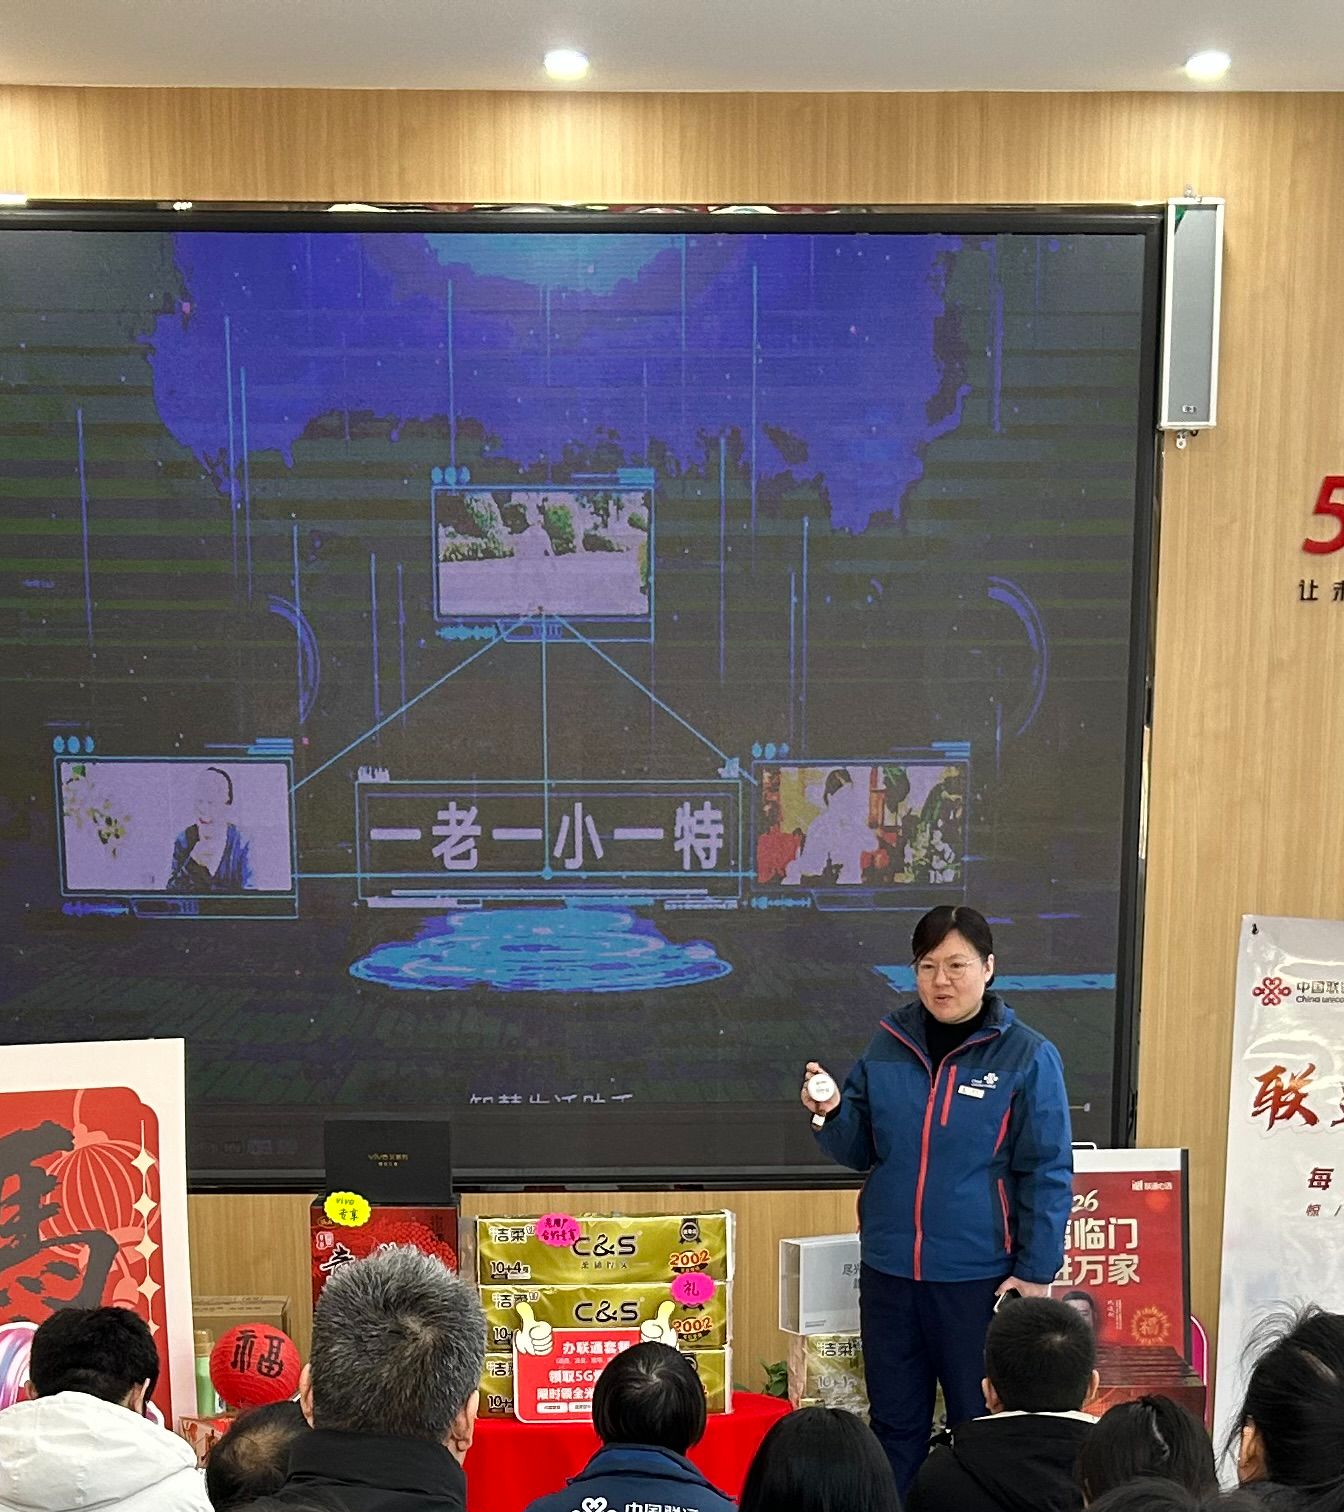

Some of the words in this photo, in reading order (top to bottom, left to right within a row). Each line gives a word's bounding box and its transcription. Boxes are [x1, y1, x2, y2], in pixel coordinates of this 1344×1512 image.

[369, 800, 724, 871] 一老一小一特
[1071, 1189, 1099, 1214] 26
[572, 1233, 636, 1257] C&S
[669, 1250, 711, 1266] 2002
[683, 1280, 700, 1297] 礼
[574, 1300, 638, 1323] C&S
